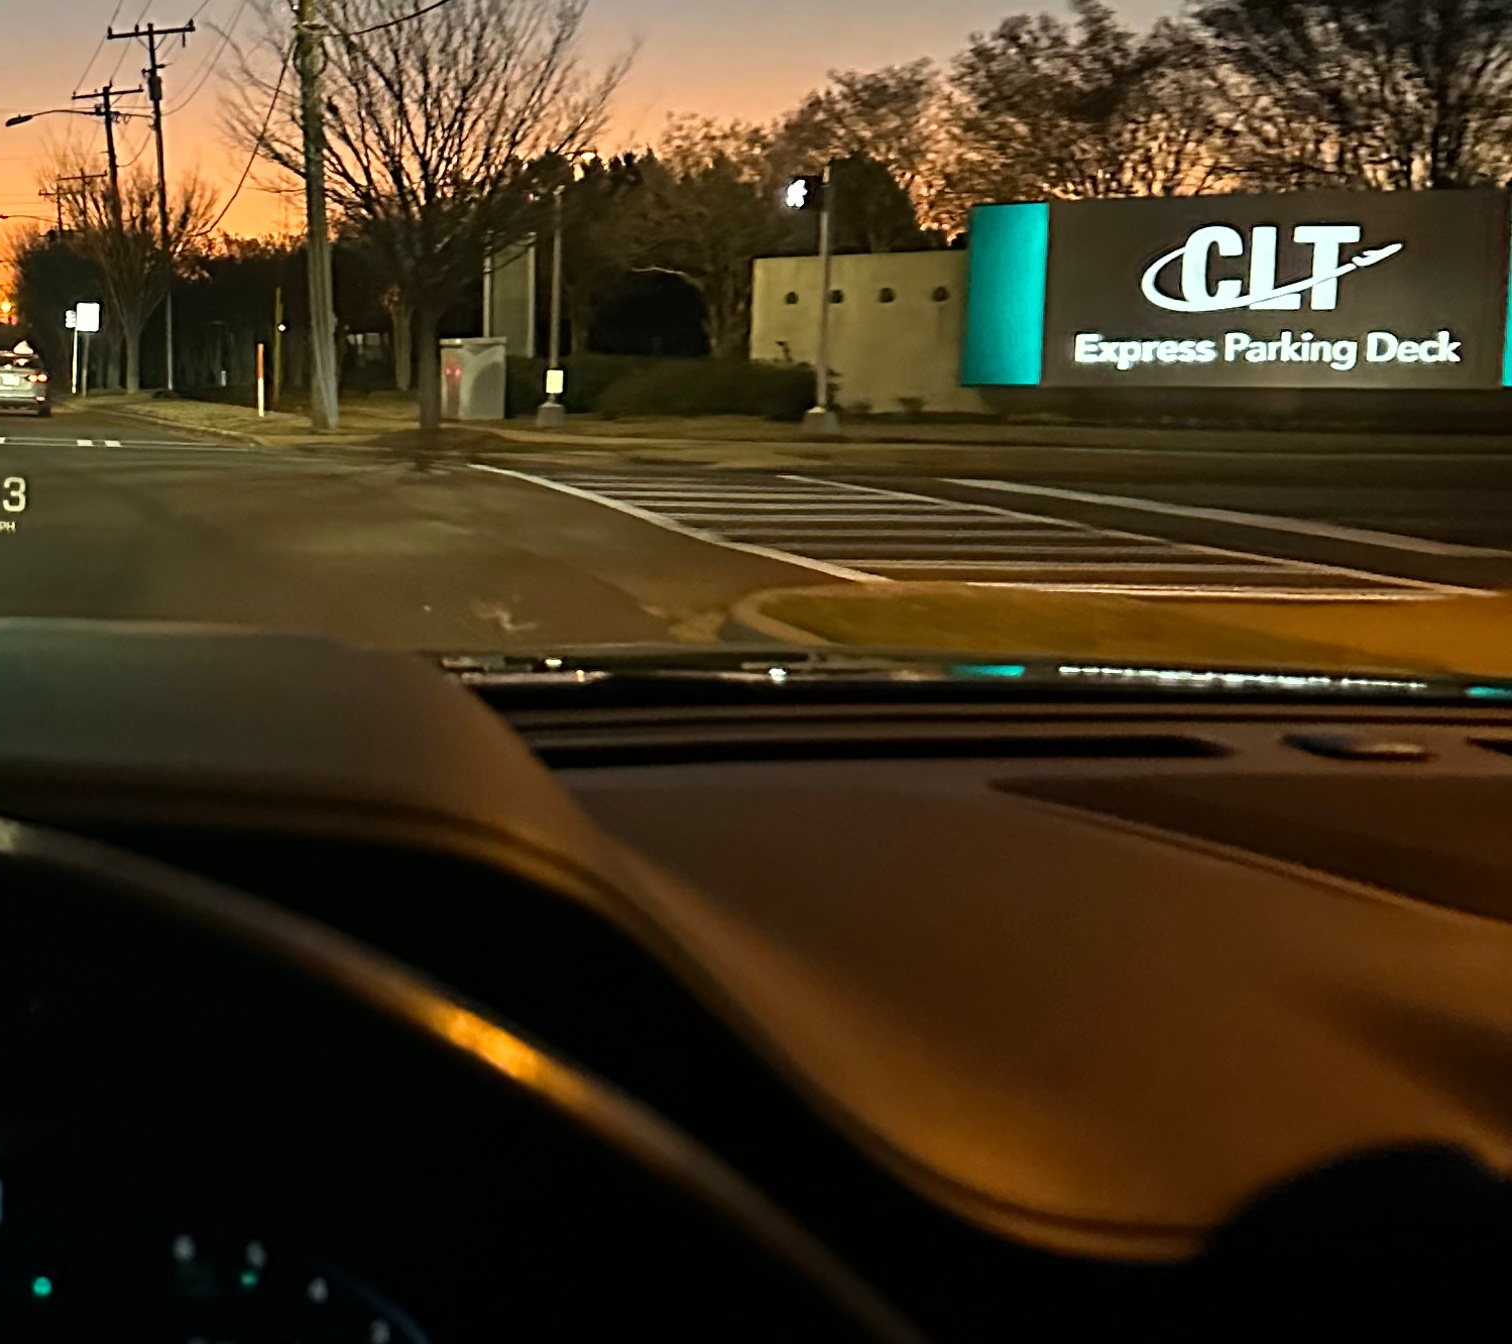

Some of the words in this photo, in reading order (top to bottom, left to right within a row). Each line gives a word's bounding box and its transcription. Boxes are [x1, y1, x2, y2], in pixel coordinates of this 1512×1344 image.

[1182, 225, 1361, 312] CLT
[1074, 333, 1217, 370] Express
[1224, 332, 1357, 370] Parking
[1366, 331, 1461, 363] Deck
